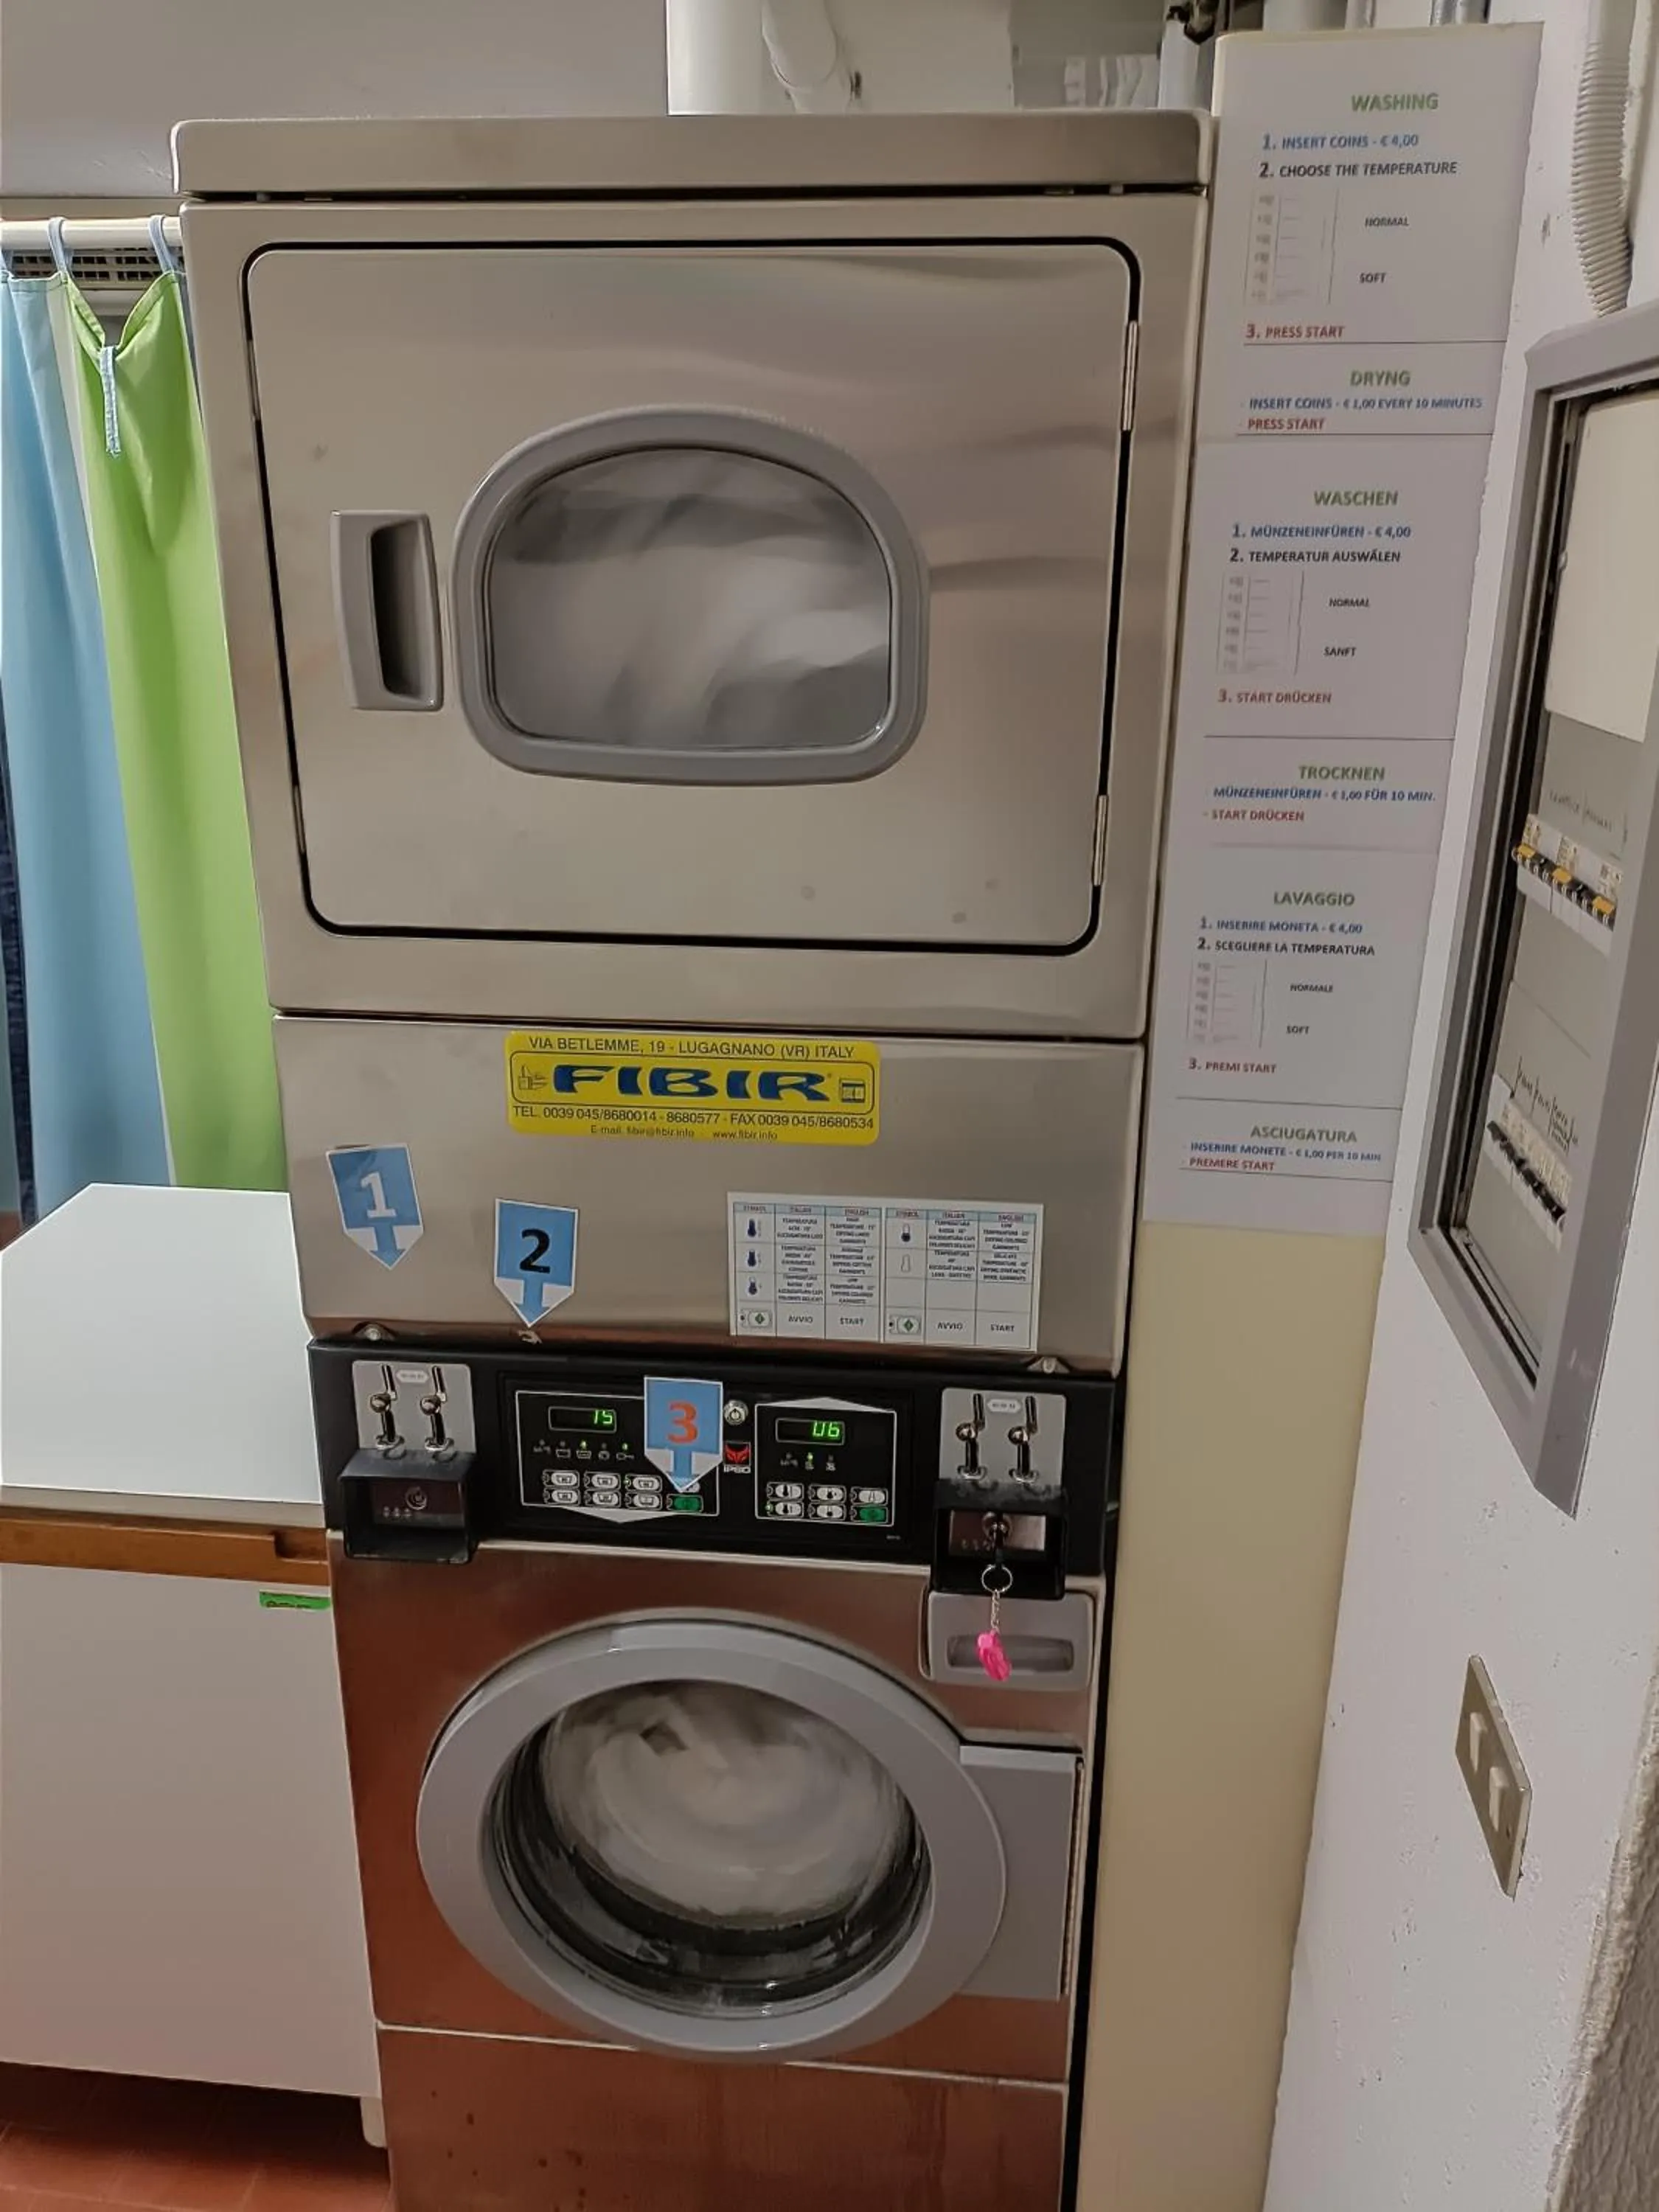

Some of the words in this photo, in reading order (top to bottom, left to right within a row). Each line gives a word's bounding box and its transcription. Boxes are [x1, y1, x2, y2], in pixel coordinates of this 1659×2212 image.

[1351, 94, 1439, 112] WASHING
[1262, 133, 1276, 150] 1.
[1282, 136, 1326, 149] INSERT
[1329, 136, 1368, 148] COINS
[1380, 136, 1388, 147] €
[1391, 134, 1419, 148] 4,00
[1259, 161, 1274, 178] 2.
[1279, 164, 1330, 178] CHOOSE
[1335, 164, 1359, 177] THE
[1363, 162, 1457, 176] TEMPERATURE
[1364, 218, 1409, 227] NORMAL
[1359, 273, 1386, 283] SOFT
[1246, 324, 1259, 338] 3.
[1265, 326, 1303, 338] PRESS
[1306, 325, 1345, 338] START
[1350, 371, 1411, 386] DRYNG
[1250, 398, 1291, 409] INSERT
[1295, 397, 1332, 408] COINS
[1343, 399, 1349, 408] €
[1352, 398, 1376, 409] 1,00
[1378, 398, 1412, 408] EVERY
[1416, 399, 1428, 408] 10
[1431, 397, 1481, 408] MINUTES
[1248, 419, 1284, 430] PRESS
[1287, 418, 1325, 429] START
[1314, 491, 1398, 506] WASCHEN
[1232, 524, 1245, 538] 1.
[1251, 525, 1364, 538] MÜNZENEINFÜREN
[1375, 526, 1382, 538] €
[1385, 526, 1411, 538] 4,00
[1230, 549, 1243, 563] 2.
[1249, 552, 1329, 563] TEMPERATUR
[1329, 599, 1369, 608] NORMAL
[1324, 647, 1355, 656] SANFT
[1218, 690, 1231, 703] 3.
[1237, 692, 1273, 703] START
[1276, 690, 1331, 703] DRÜCKEN
[1299, 765, 1385, 780] TROCKNEN
[1214, 786, 1321, 799] MÜNZENEINFÜREN
[1332, 790, 1338, 800] €
[1340, 790, 1362, 801] 1,00
[1365, 788, 1387, 800] FÜR
[1391, 791, 1405, 801] 10
[1408, 791, 1436, 801] MIN.
[1212, 810, 1246, 821] START
[1250, 809, 1304, 821] DRÜCKEN
[1273, 892, 1354, 906] LAVAGGIO
[1200, 917, 1211, 929] 1.
[1217, 921, 1267, 931] INSERIRE
[1269, 922, 1319, 933] MONETA
[1329, 923, 1335, 933] €
[1339, 923, 1363, 933] 4,00
[1197, 938, 1211, 950] 2.
[1215, 941, 1272, 952] SCEGLIERE
[1275, 942, 1287, 953] LA
[1290, 944, 1375, 956] TEMPERATURA
[1290, 984, 1333, 993] NORMALE
[1287, 1026, 1310, 1034] SOFT
[529, 1037, 552, 1049] VIA
[557, 1038, 644, 1053] BETLEMME,
[649, 1041, 664, 1052] 19
[679, 1043, 775, 1057] LUGAGNANO
[780, 1045, 810, 1060] (VR)
[814, 1046, 854, 1057] ITALY
[1189, 1058, 1201, 1070] 3.
[1206, 1062, 1240, 1072] PREMI
[1243, 1063, 1276, 1073] START
[554, 1065, 830, 1102] FIBIR
[543, 1107, 574, 1119] 0039
[574, 1108, 656, 1121] 045/8680014
[667, 1112, 720, 1124] 8680577
[731, 1114, 755, 1126] FAX
[757, 1115, 789, 1127] 0039
[791, 1116, 873, 1129] 045/8680534
[1251, 1126, 1357, 1142] ASCIUGATURA
[1191, 1143, 1237, 1153] INSERIRE
[1239, 1144, 1286, 1156] MONETE
[1295, 1149, 1301, 1158] €
[1304, 1149, 1324, 1159] 1,00
[1326, 1151, 1344, 1160] PER
[1347, 1152, 1358, 1160] 10
[1360, 1152, 1380, 1161] MIN
[1190, 1159, 1239, 1169] PREMERE
[1242, 1161, 1275, 1171] START
[361, 1172, 397, 1218] 1
[519, 1228, 551, 1274] 2
[594, 1409, 613, 1425] 15
[667, 1401, 698, 1444] 3
